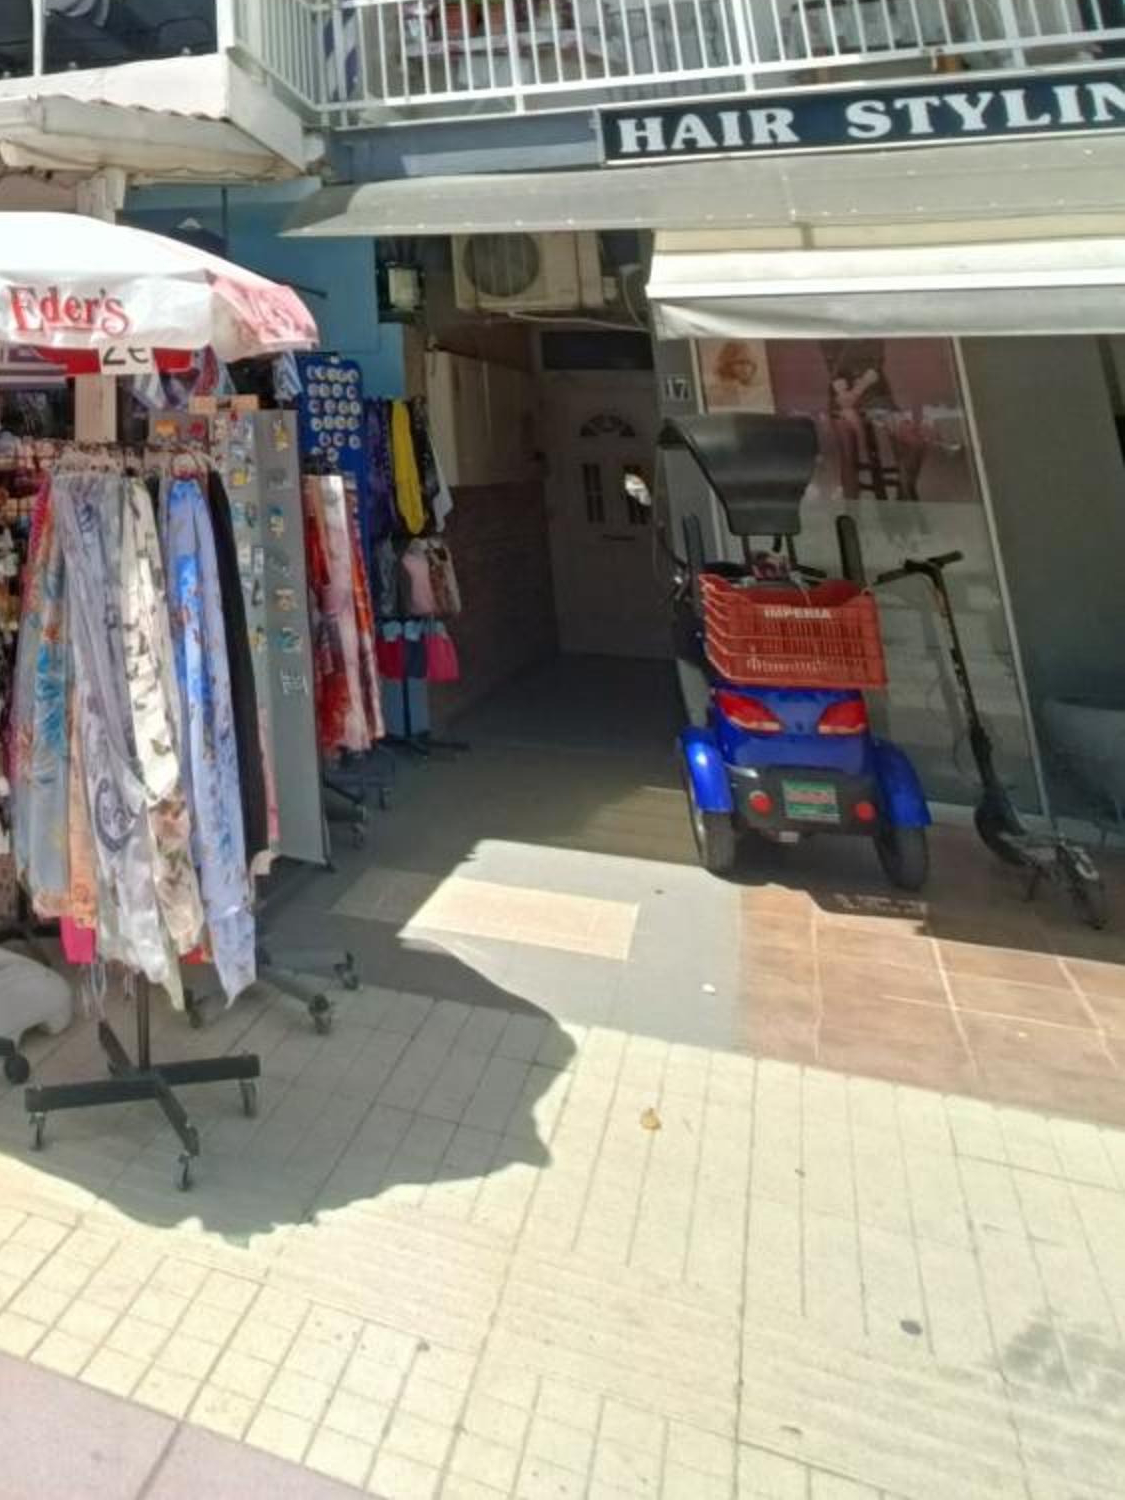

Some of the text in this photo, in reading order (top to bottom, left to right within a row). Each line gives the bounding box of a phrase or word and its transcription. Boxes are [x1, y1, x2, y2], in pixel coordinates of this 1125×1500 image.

[618, 81, 1125, 152] HAIR STYLIN
[6, 285, 131, 337] Eder's
